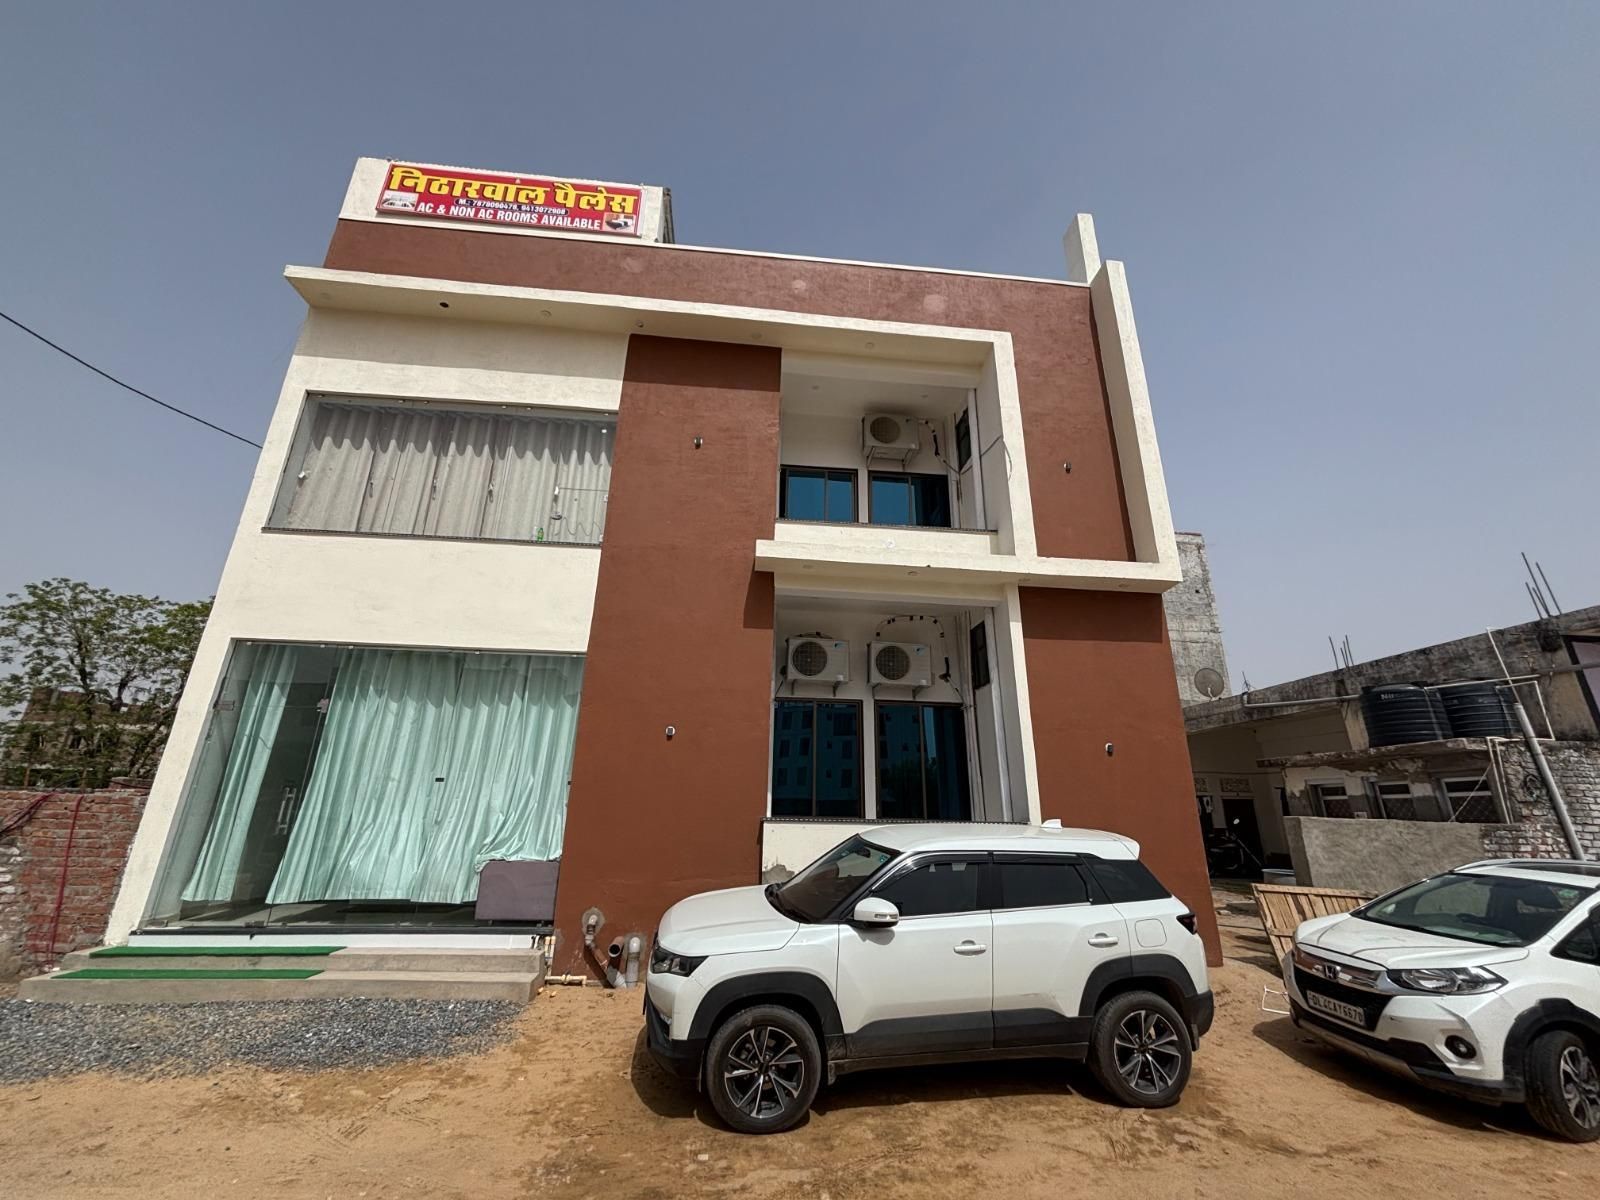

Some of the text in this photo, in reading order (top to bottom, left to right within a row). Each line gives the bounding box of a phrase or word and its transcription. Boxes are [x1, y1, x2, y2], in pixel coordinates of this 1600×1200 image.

[389, 166, 638, 214] निठारवाल पैलेस
[417, 202, 602, 229] AC & NON AC ROOMS AVAILABLE
